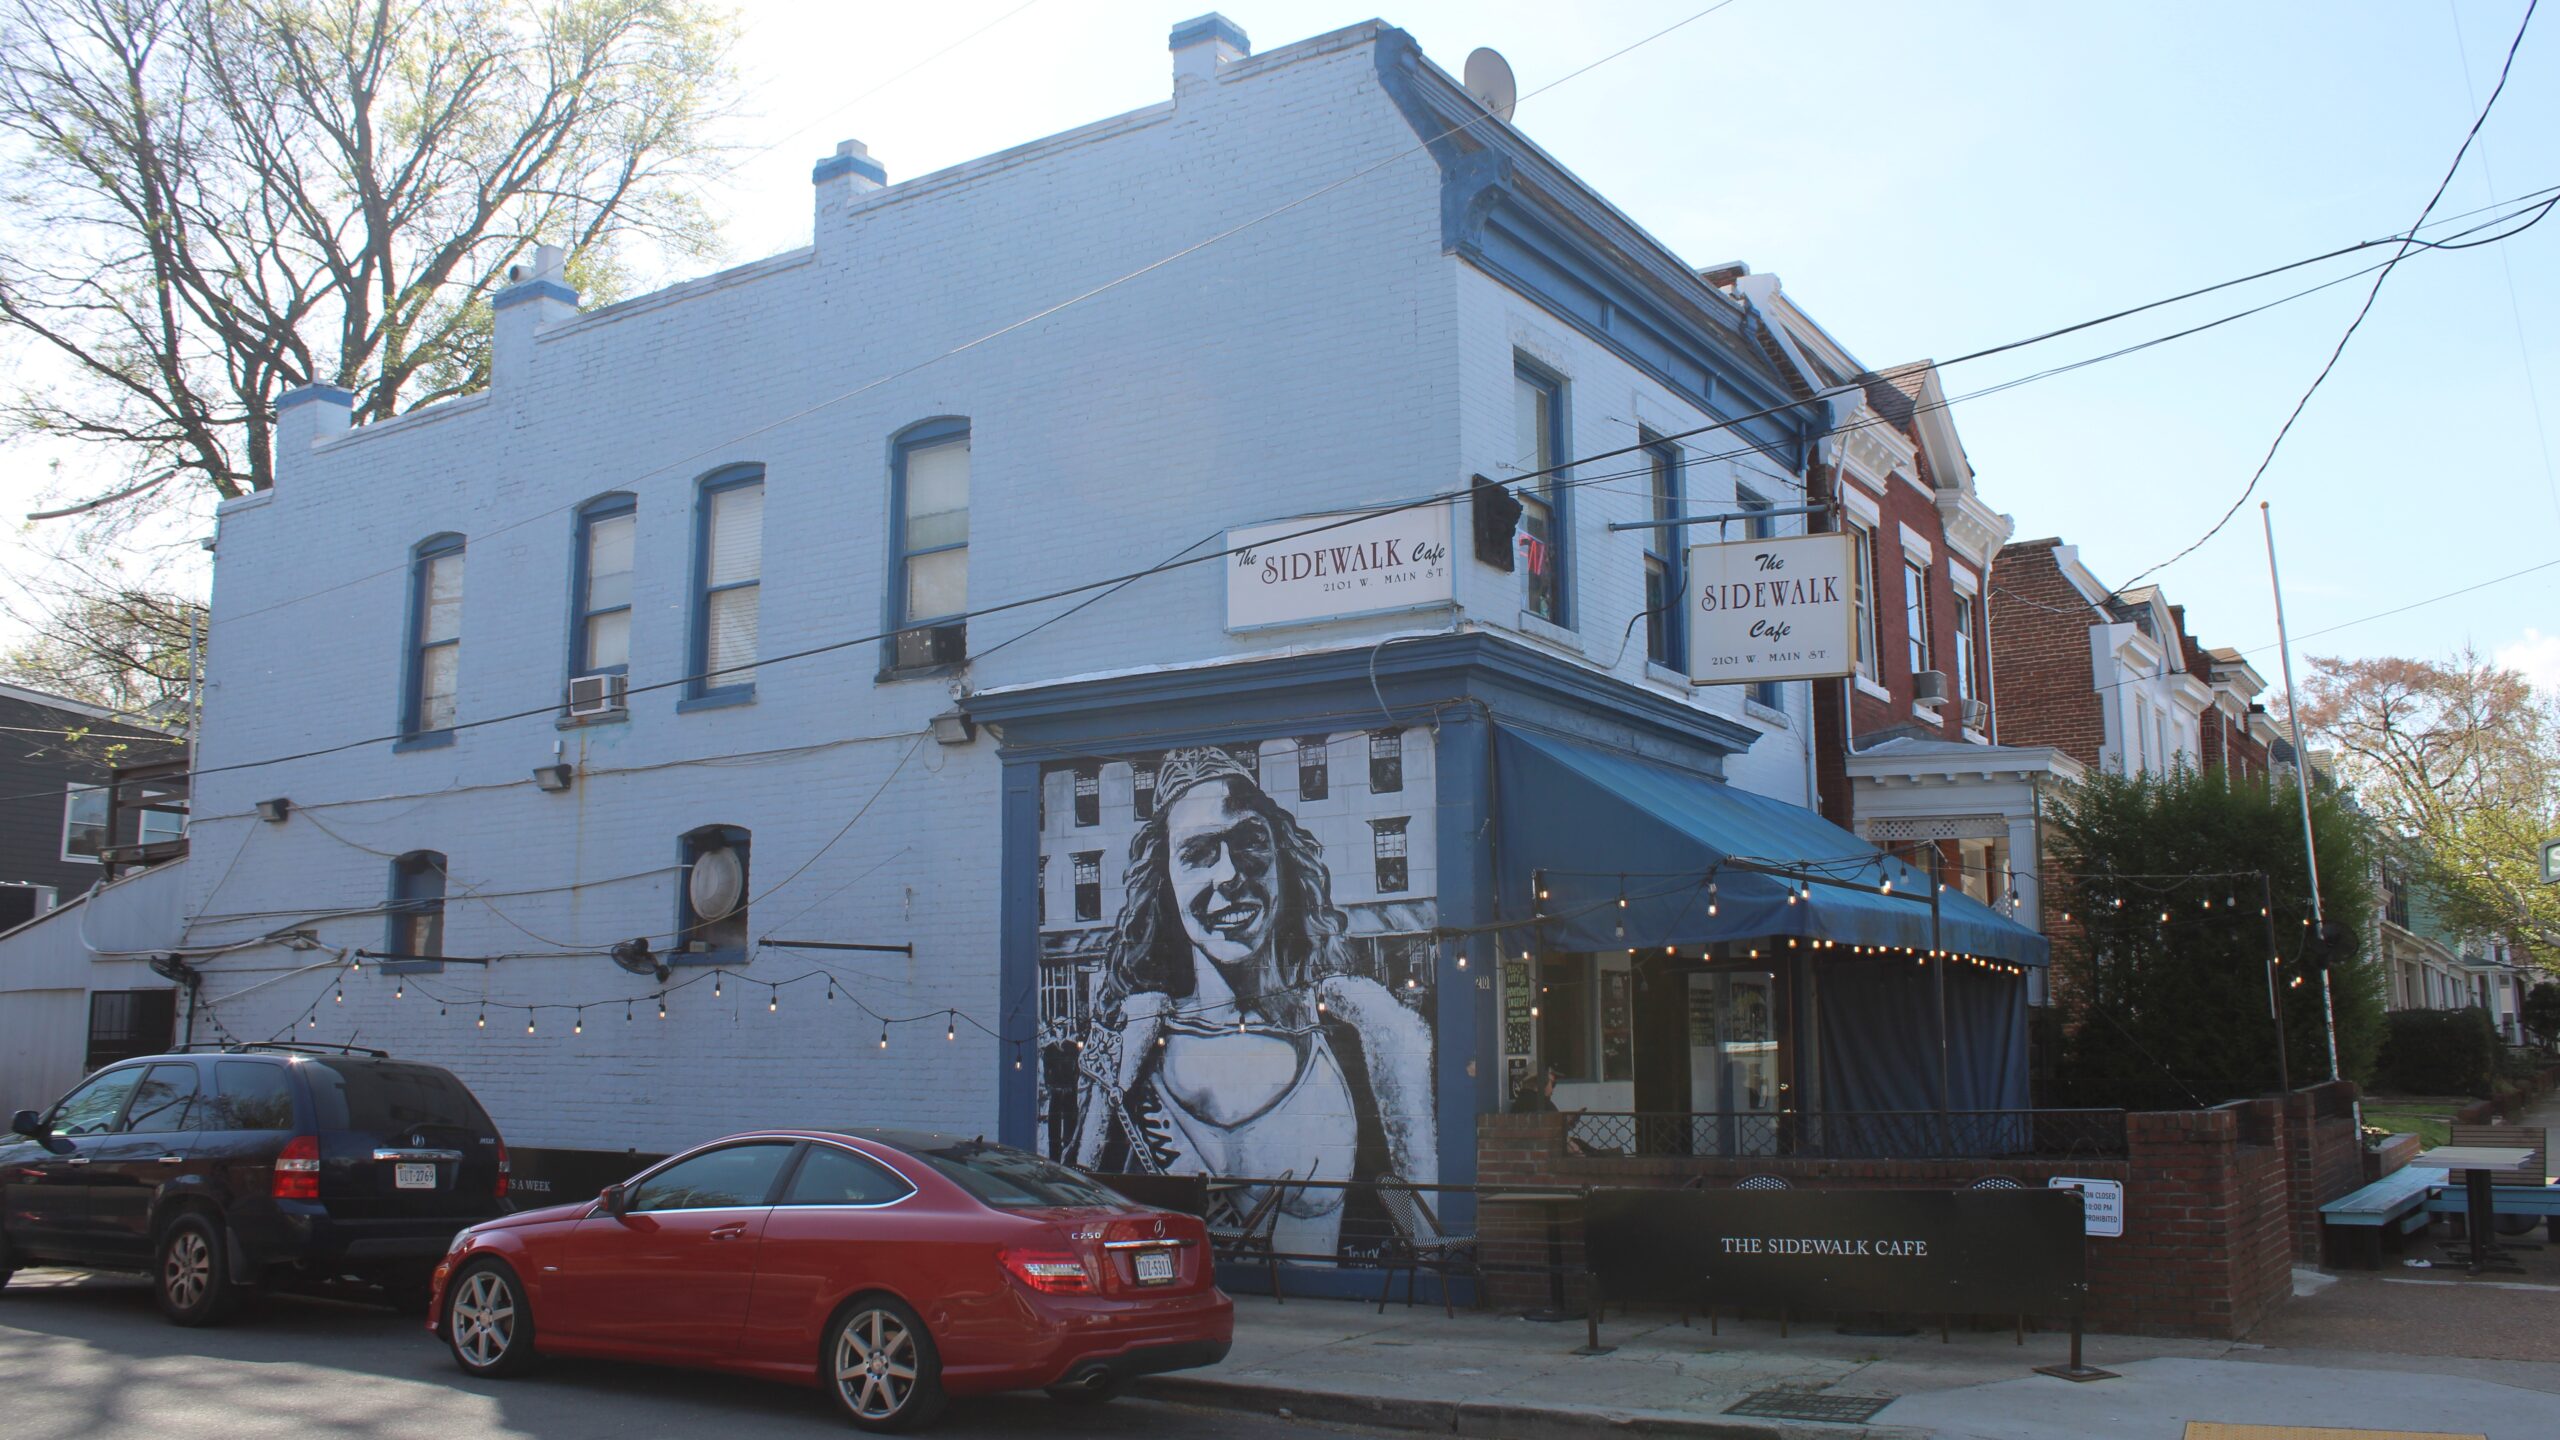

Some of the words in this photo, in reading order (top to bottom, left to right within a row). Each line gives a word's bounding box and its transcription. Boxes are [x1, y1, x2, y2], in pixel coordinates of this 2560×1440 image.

[1235, 549, 1257, 568] The
[1261, 538, 1403, 585] SIDEWALK
[1412, 542, 1446, 567] Cafe
[1754, 553, 1785, 572] The
[1323, 581, 1351, 592] 2101
[1359, 577, 1373, 588] W.
[1384, 571, 1417, 584] MAIN
[1701, 576, 1840, 612] SIDEWALK
[1749, 619, 1791, 643] Cafe
[1712, 656, 1739, 666] 2101
[1746, 654, 1760, 664] W.
[1769, 652, 1801, 662] MAIN
[517, 1180, 524, 1190] A
[525, 1180, 552, 1192] WEEK
[2095, 1191, 2116, 1200] CLOSED
[2085, 1203, 2102, 1211] 10:00
[2103, 1203, 2113, 1211] PM
[2085, 1214, 2118, 1223] PROHIBITED
[1080, 1231, 1101, 1239] 250
[1721, 1238, 1762, 1253] THE
[1768, 1238, 1870, 1255] SIDEWALK
[1875, 1240, 1928, 1256] CAFE
